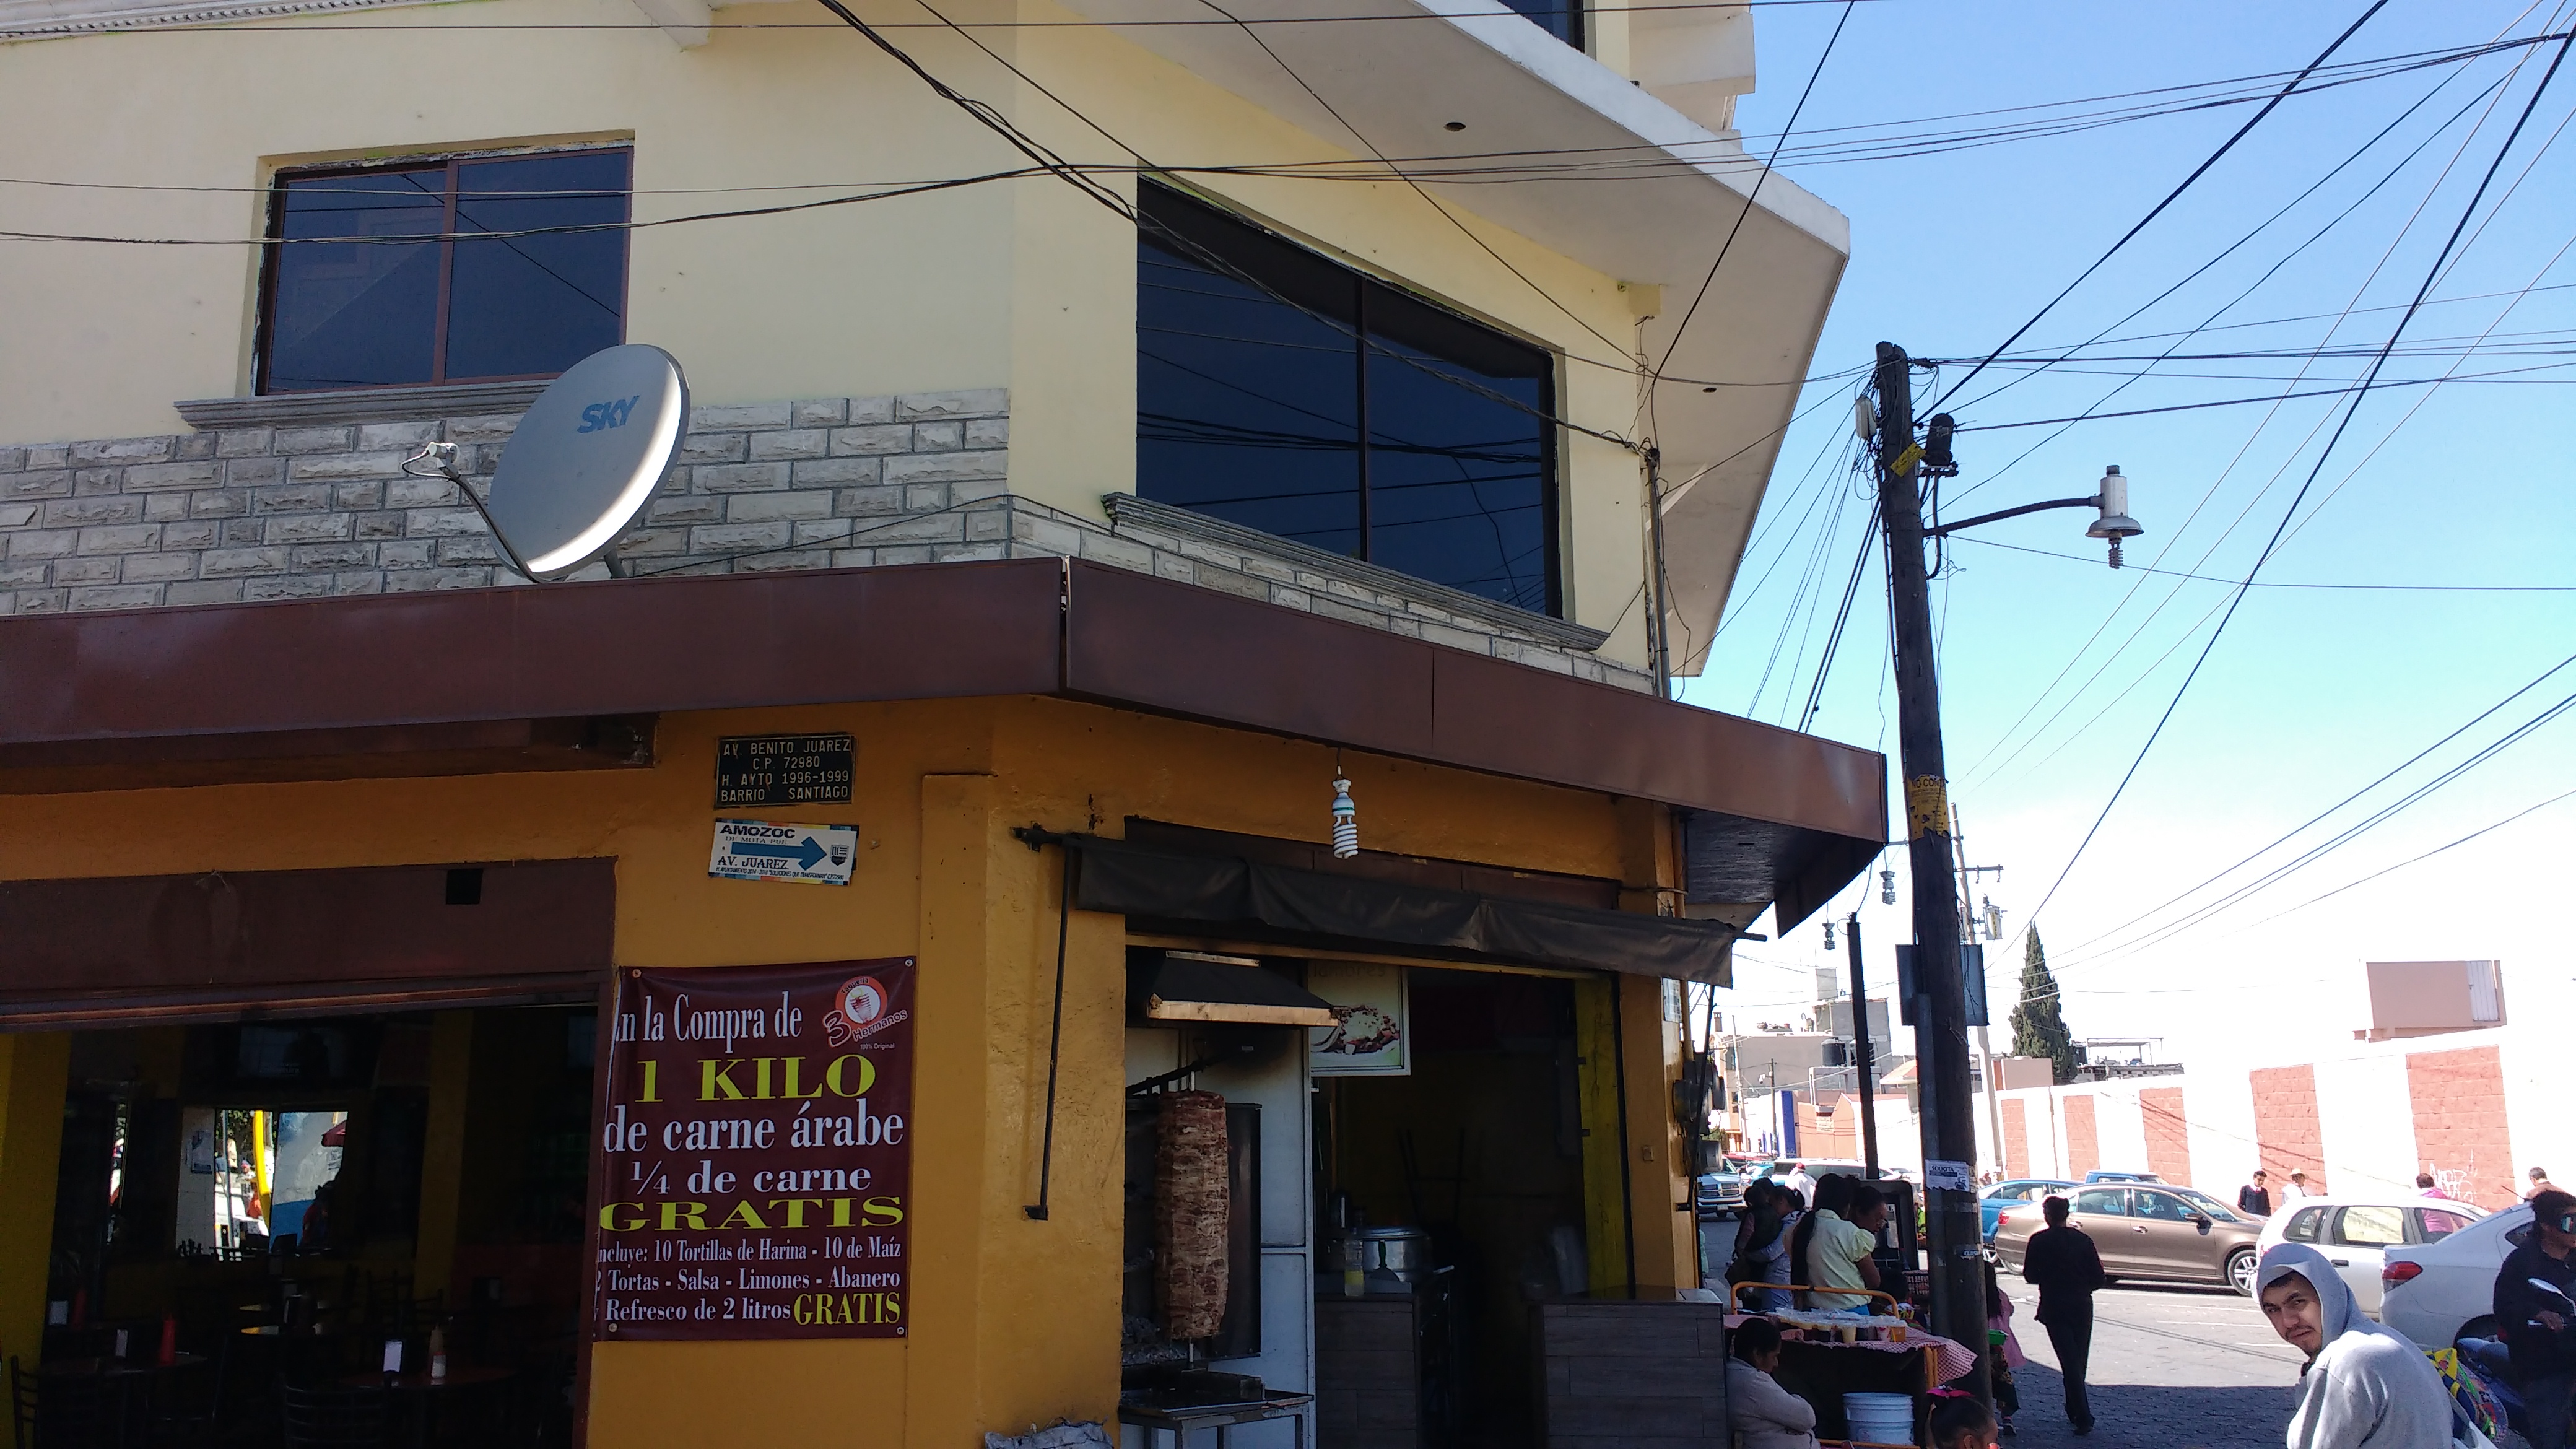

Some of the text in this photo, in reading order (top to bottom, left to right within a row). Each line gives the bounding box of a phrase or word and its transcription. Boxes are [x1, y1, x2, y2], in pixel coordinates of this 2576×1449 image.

[577, 394, 641, 434] SKY
[751, 741, 794, 755] BENITO
[803, 739, 851, 754] JUAREZ
[783, 755, 820, 770] 72980
[781, 770, 850, 785] 1996-1999
[721, 785, 848, 802] BARRIO SANTIAGO
[720, 824, 796, 838] AMOZOC
[717, 856, 738, 866] AV.
[1308, 961, 1386, 978] lambres
[642, 994, 665, 1042] la
[674, 993, 767, 1054] Compra
[774, 991, 803, 1038] de
[822, 1009, 853, 1048] 3
[851, 1009, 908, 1042] Hermanos
[873, 1042, 895, 1051] Original
[635, 1054, 876, 1103] 1 KILO
[603, 1097, 904, 1153] de carne árabe
[687, 1159, 737, 1194] de
[753, 1167, 872, 1193] carne
[599, 1196, 904, 1232] GRATIS
[654, 1239, 672, 1262] 10
[676, 1238, 733, 1262] Tortillas
[737, 1238, 754, 1261] de
[759, 1238, 807, 1261] Harina
[824, 1236, 843, 1260] 10
[846, 1237, 863, 1258] de
[867, 1235, 902, 1258] Maíz
[607, 1269, 659, 1291] Tortas
[677, 1268, 720, 1291] Salsa
[738, 1268, 810, 1290] Limones
[827, 1265, 902, 1289] Abanero
[604, 1298, 687, 1321] Refresco
[694, 1297, 716, 1320] de
[722, 1297, 736, 1320] 2
[742, 1296, 791, 1320] litros
[793, 1292, 902, 1325] GRATIS
